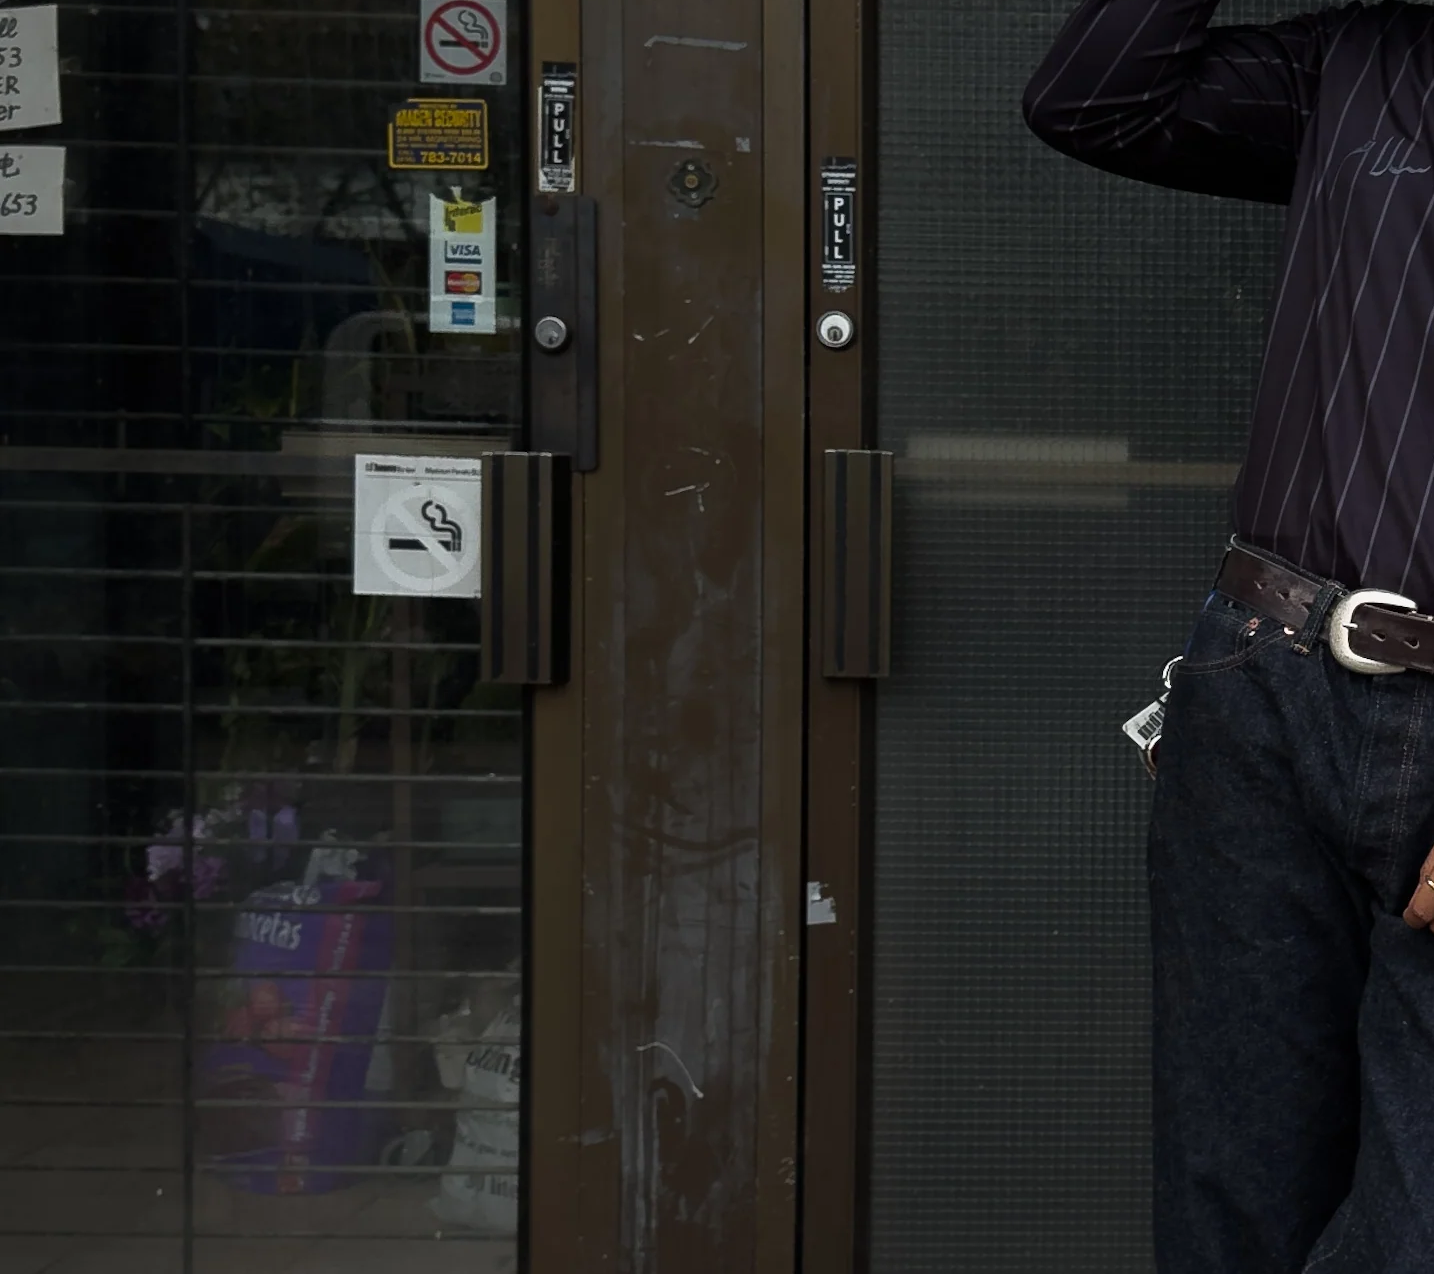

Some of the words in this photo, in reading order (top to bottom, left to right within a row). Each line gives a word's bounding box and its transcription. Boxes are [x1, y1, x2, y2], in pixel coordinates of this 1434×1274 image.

[552, 101, 566, 165] PULL
[450, 244, 481, 257] VISA
[832, 197, 846, 260] PULL
